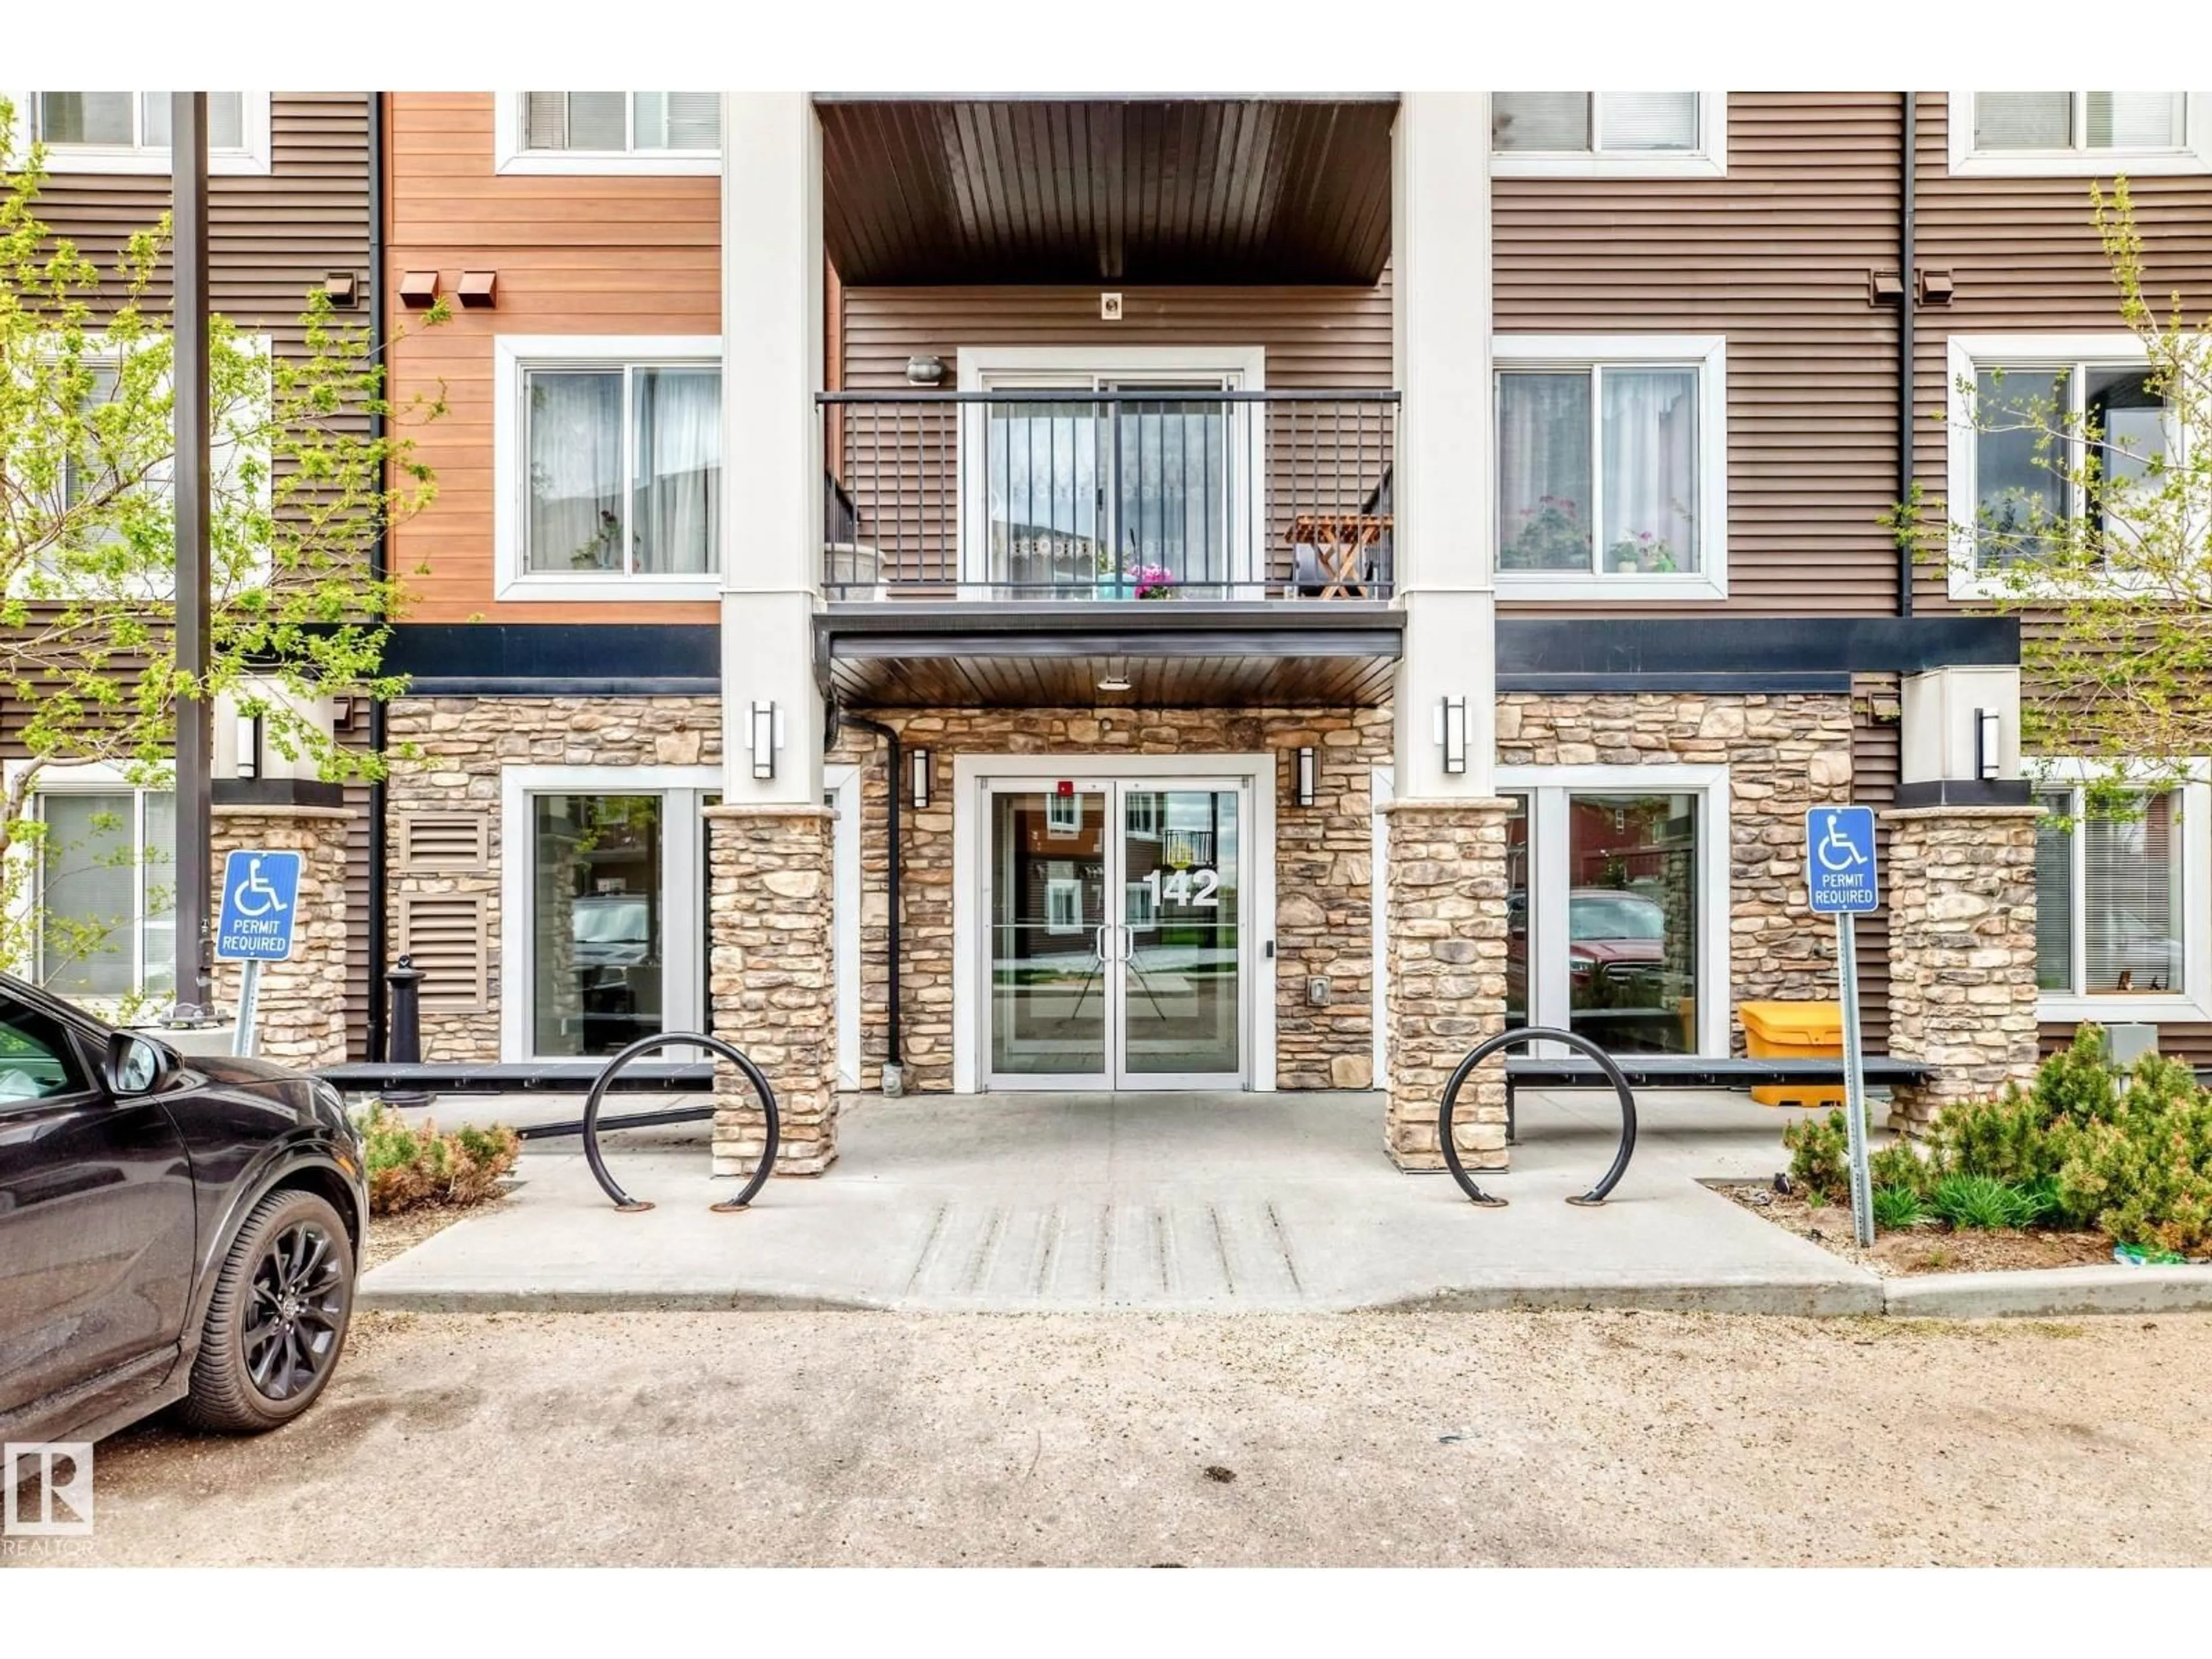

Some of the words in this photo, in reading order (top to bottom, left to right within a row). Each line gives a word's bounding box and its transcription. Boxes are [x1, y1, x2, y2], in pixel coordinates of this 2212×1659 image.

[1143, 869, 1219, 906] 142
[1823, 874, 1864, 887] PERMIT
[1816, 890, 1872, 904] REQUIRED
[234, 920, 279, 933] PERMIT
[223, 937, 285, 951] REQUIRED
